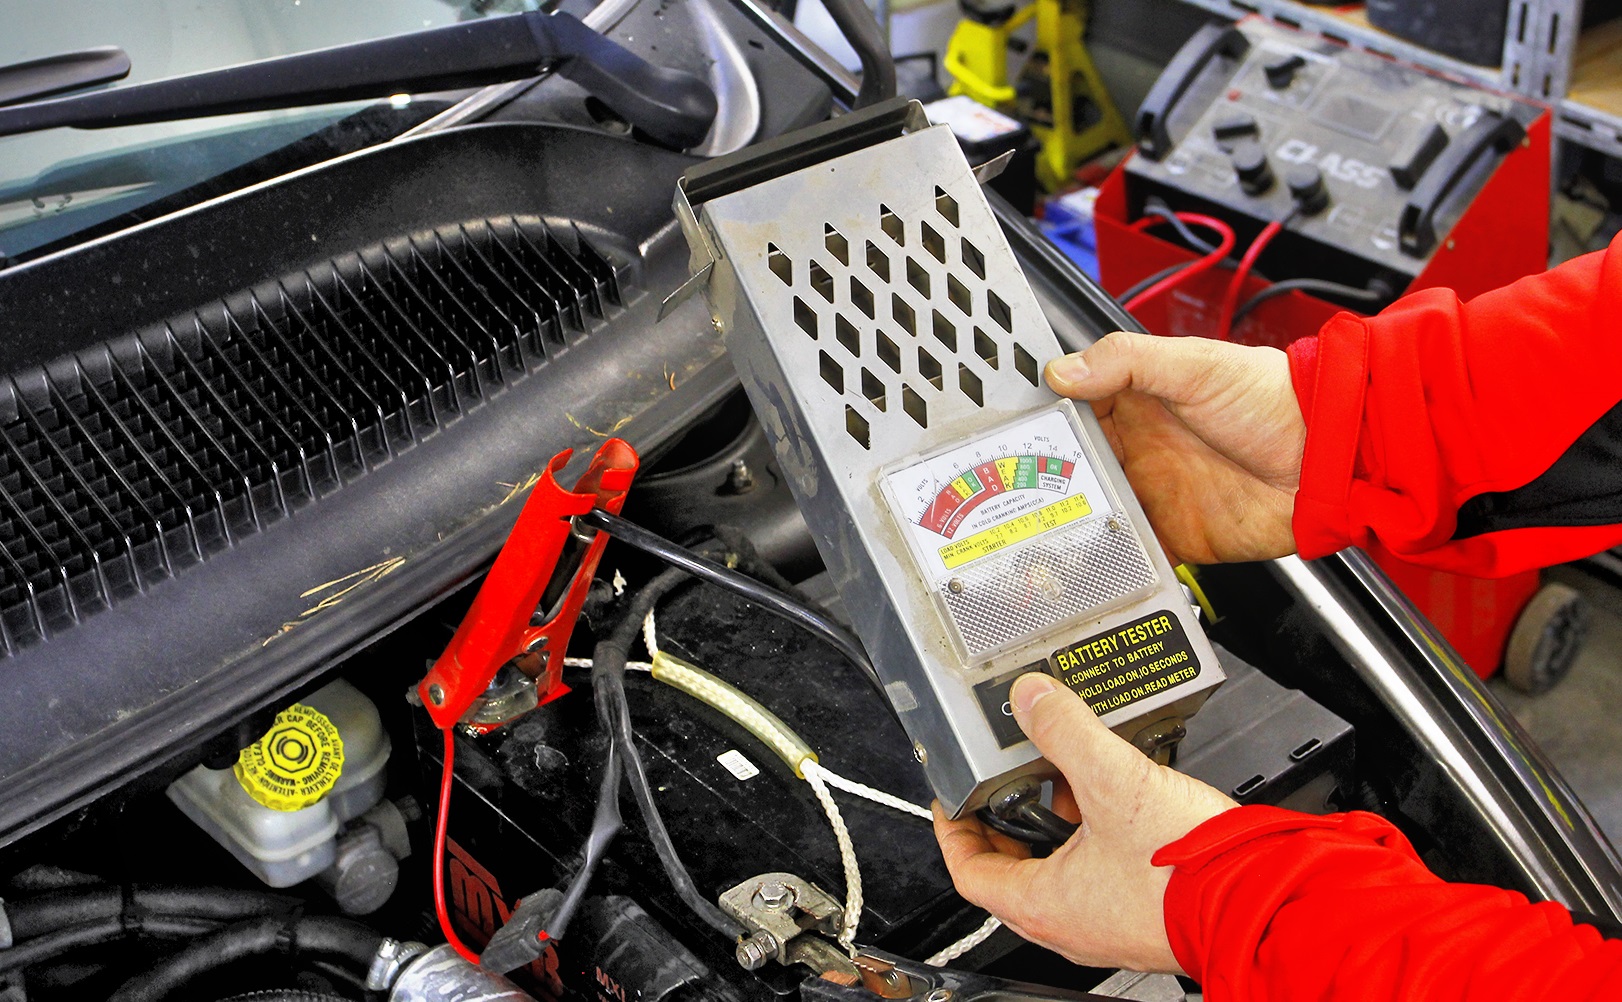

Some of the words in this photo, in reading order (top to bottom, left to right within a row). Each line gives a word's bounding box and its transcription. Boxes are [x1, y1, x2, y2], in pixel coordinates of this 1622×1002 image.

[1073, 450, 1082, 458] 16
[916, 478, 929, 492] VOLTS
[967, 476, 977, 488] OK
[983, 468, 998, 492] BAD
[997, 461, 1011, 489] WEAK
[1040, 474, 1066, 485] CHARGING
[1042, 482, 1062, 490] SYSTEM
[917, 495, 925, 503] 2
[945, 490, 961, 504] BAD
[980, 504, 1001, 516] BATTERY
[1002, 494, 1026, 506] CAPACITY
[978, 518, 992, 528] COLD
[992, 508, 1018, 522] CRANKING
[940, 546, 954, 555] LOAD
[954, 540, 970, 549] VOLTS
[1004, 522, 1014, 530] 10.4
[957, 546, 973, 556] CRANK
[974, 538, 989, 548] VOLTS
[982, 540, 1007, 554] STARTER
[1043, 519, 1057, 528] TEST
[1057, 634, 1119, 671] BATTERY
[1118, 615, 1173, 647] TESTER
[1065, 661, 1111, 687] 1.CONNECT
[1112, 656, 1126, 669] TO
[1126, 640, 1165, 663] BATTERY
[1078, 684, 1103, 700] HOLD
[1101, 674, 1126, 692] LOAD
[1148, 650, 1189, 673] SECONDS
[1107, 692, 1132, 708] LOAD
[1167, 666, 1197, 685] METER
[286, 714, 304, 723] CAP
[306, 719, 330, 748] BEFORE
[331, 738, 342, 761] AVANT
[302, 752, 331, 785] REMOVING
[330, 761, 339, 772] DE
[260, 776, 296, 796] ATTENTION
[300, 773, 334, 796] L'ENLEVER
